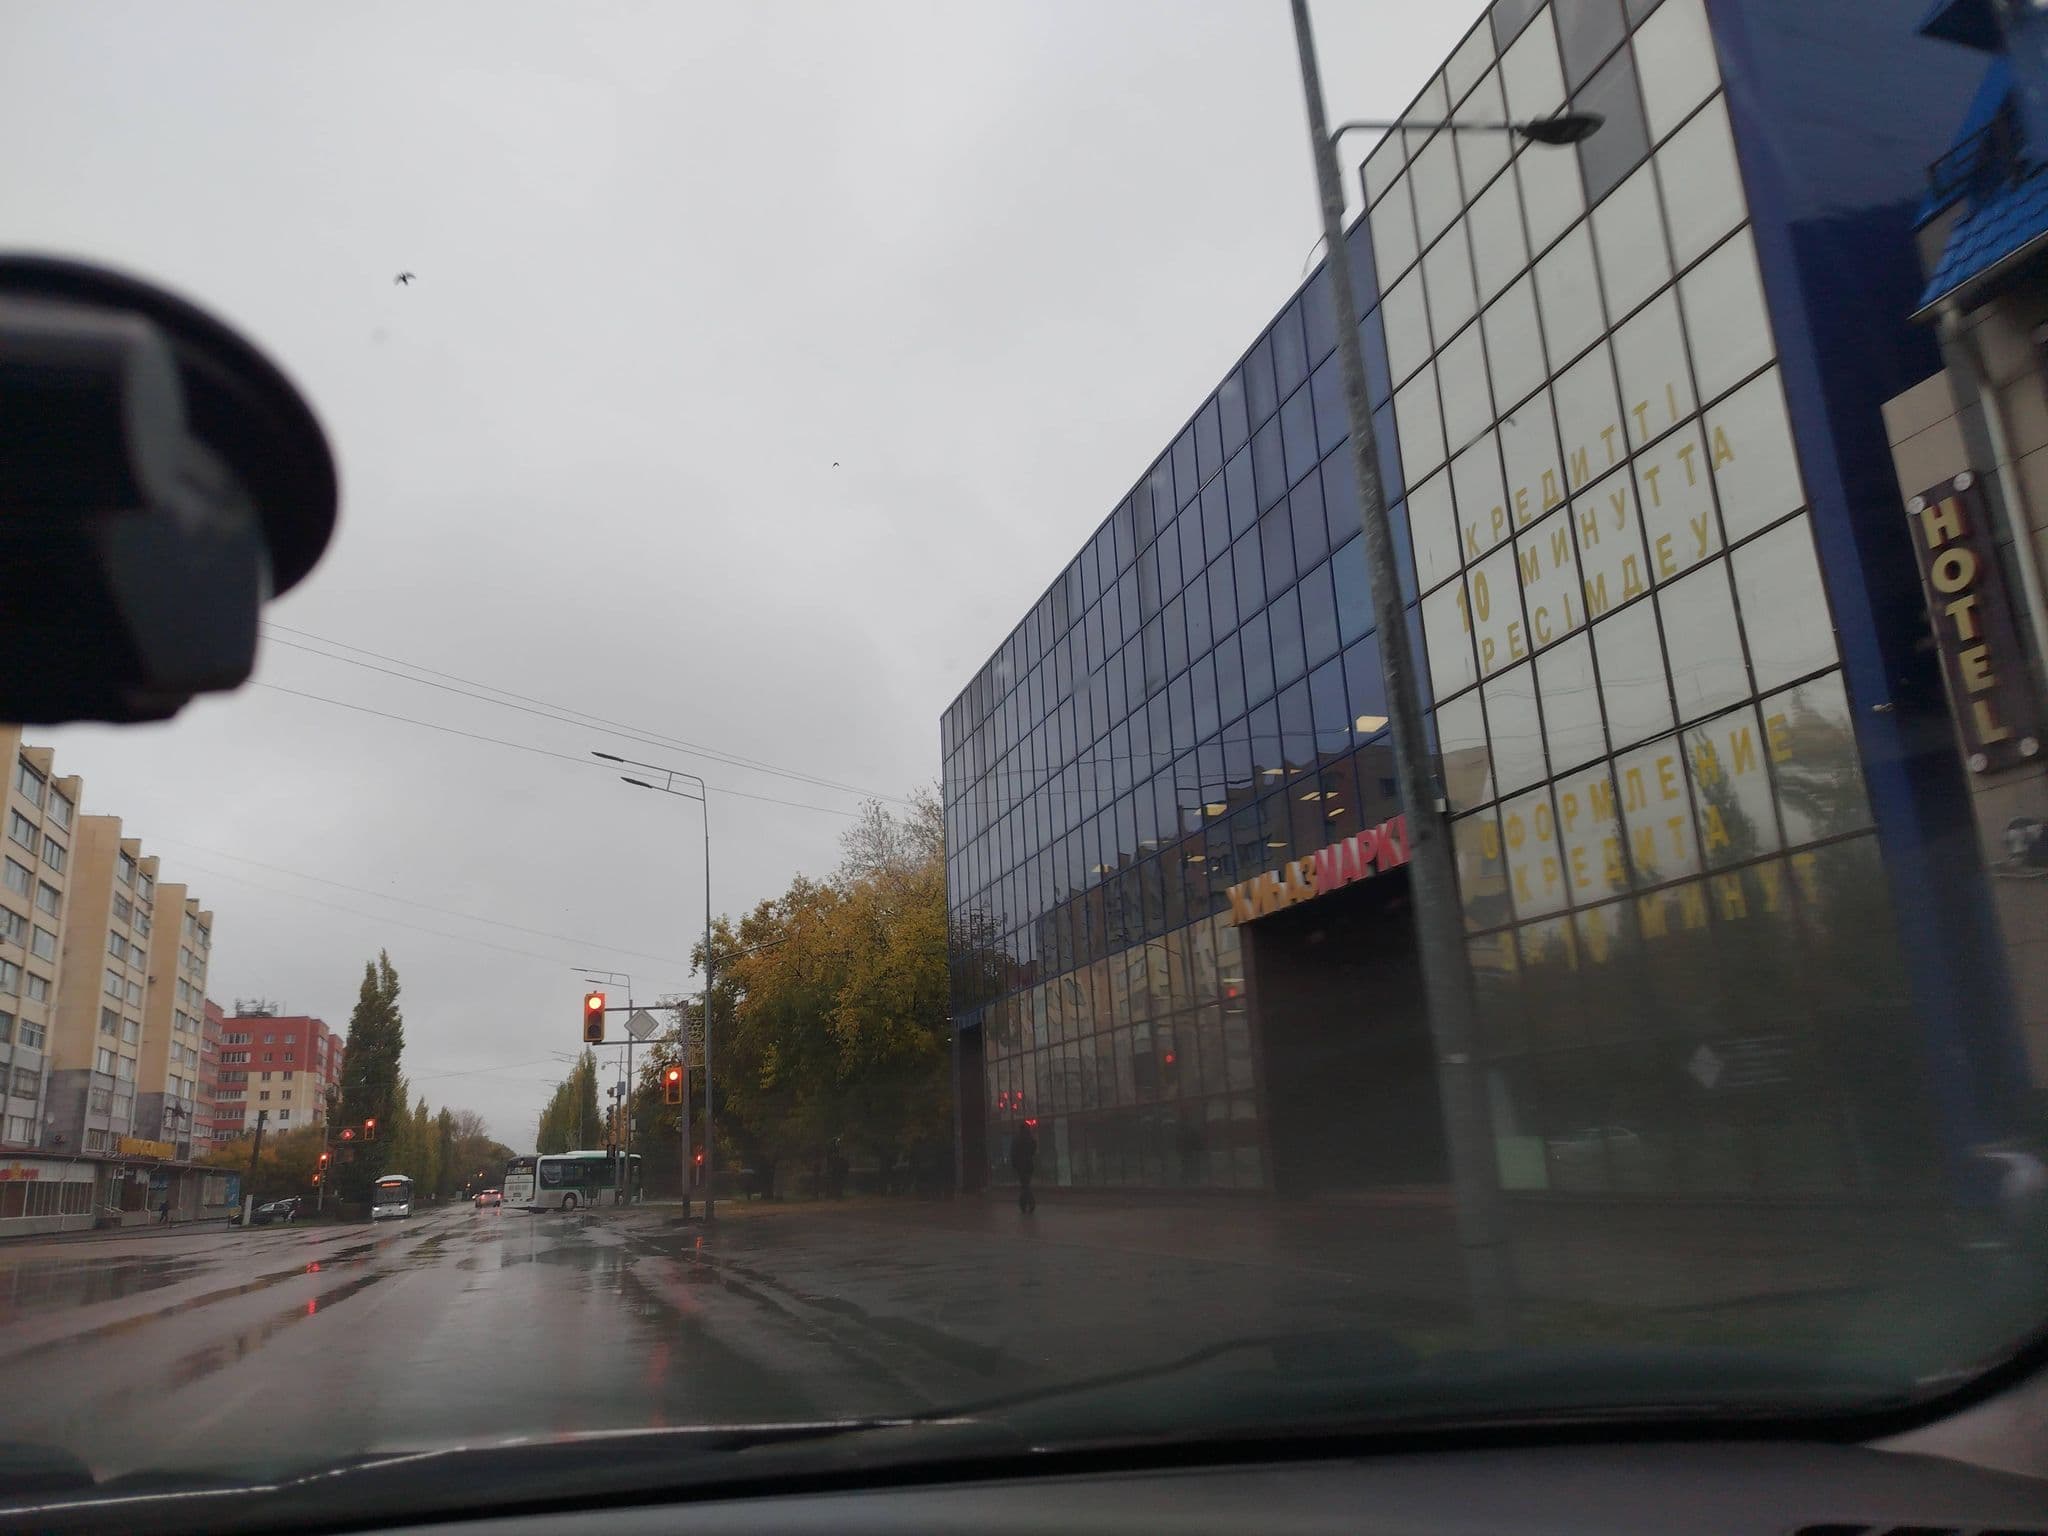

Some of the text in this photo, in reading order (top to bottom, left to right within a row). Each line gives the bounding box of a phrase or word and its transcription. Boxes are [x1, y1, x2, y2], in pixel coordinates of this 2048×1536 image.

[1456, 425, 1735, 633] 10 МИНУТТА
[1466, 383, 1679, 560] КРЕДИТТІ
[1481, 511, 1710, 673] РЕСІМДЕУ
[1920, 496, 2009, 745] HOTEL
[1481, 712, 1794, 860] ОФОРМЛЕНИЕ
[1512, 804, 1730, 903] КРЕДИТА
